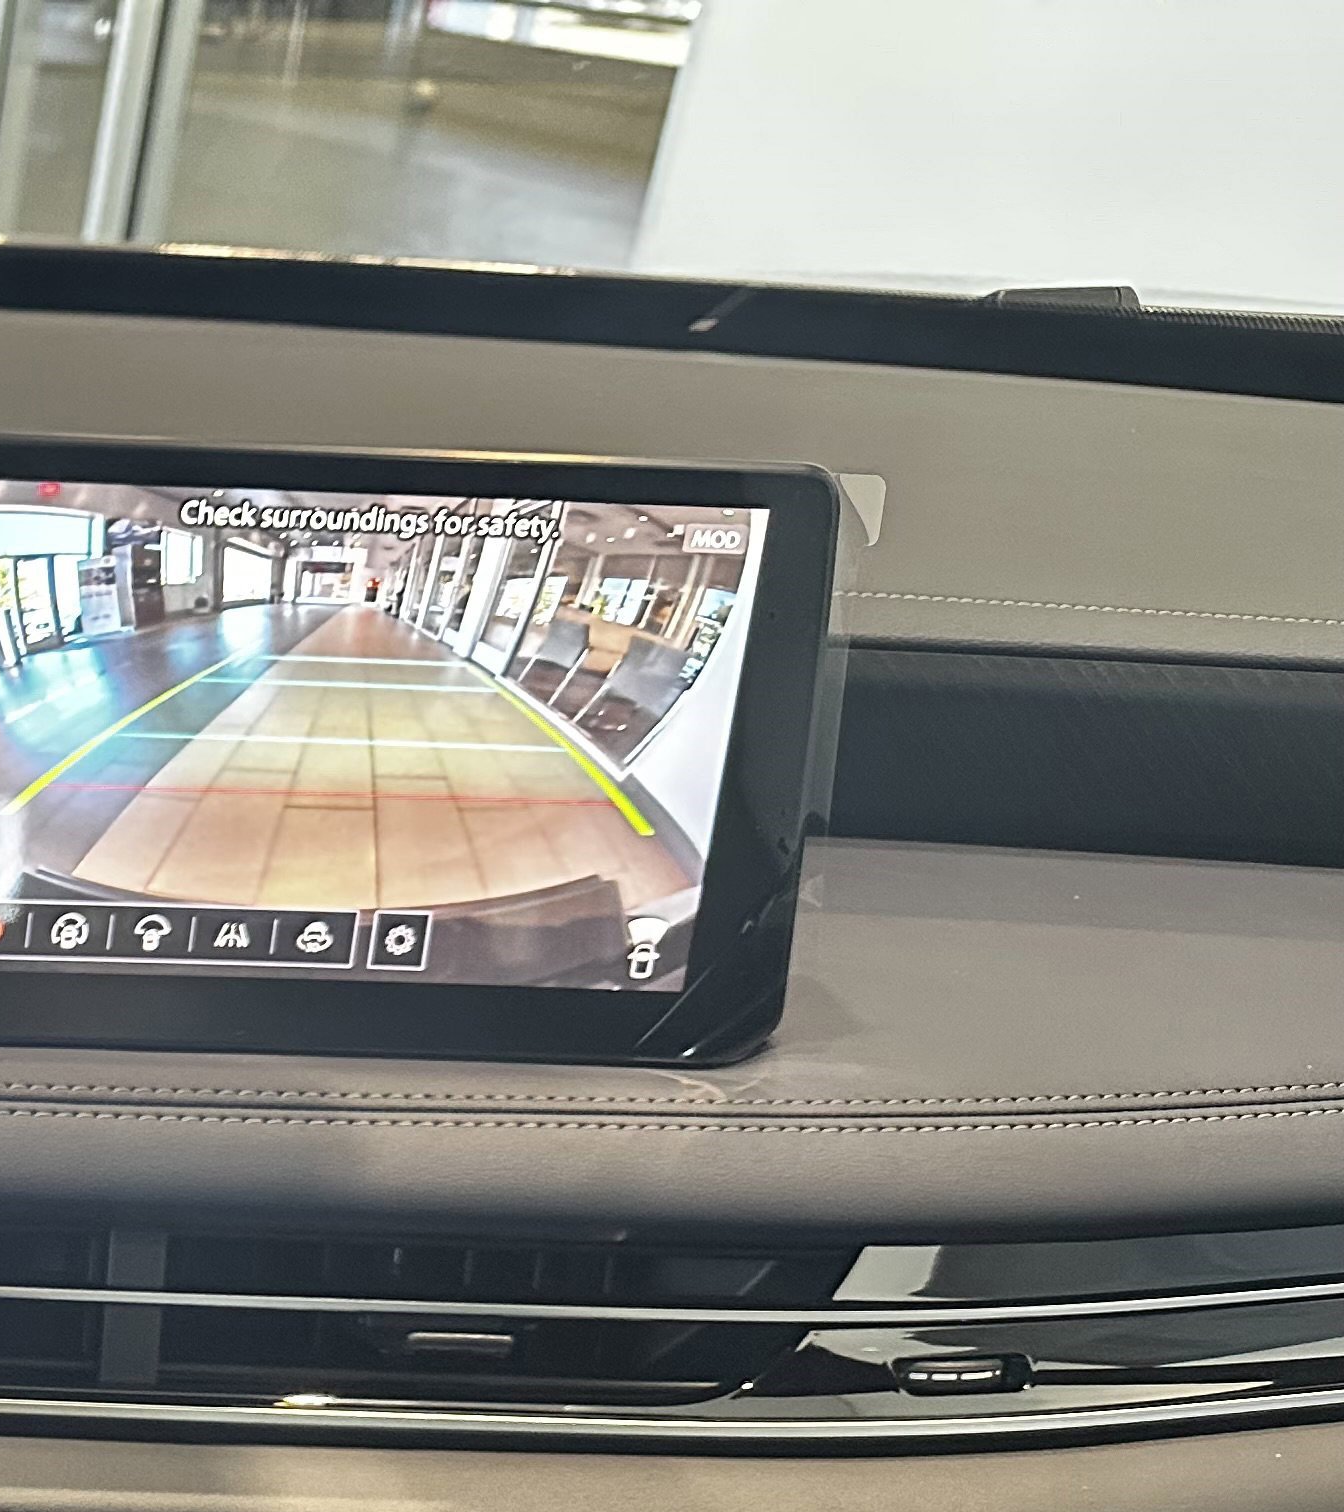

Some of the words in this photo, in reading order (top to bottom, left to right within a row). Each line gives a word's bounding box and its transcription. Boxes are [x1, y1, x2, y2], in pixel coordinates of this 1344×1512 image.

[180, 499, 257, 528] Check
[261, 506, 428, 538] surroundings
[434, 508, 472, 534] for
[477, 511, 560, 545] safety.
[691, 530, 741, 548] MOD
